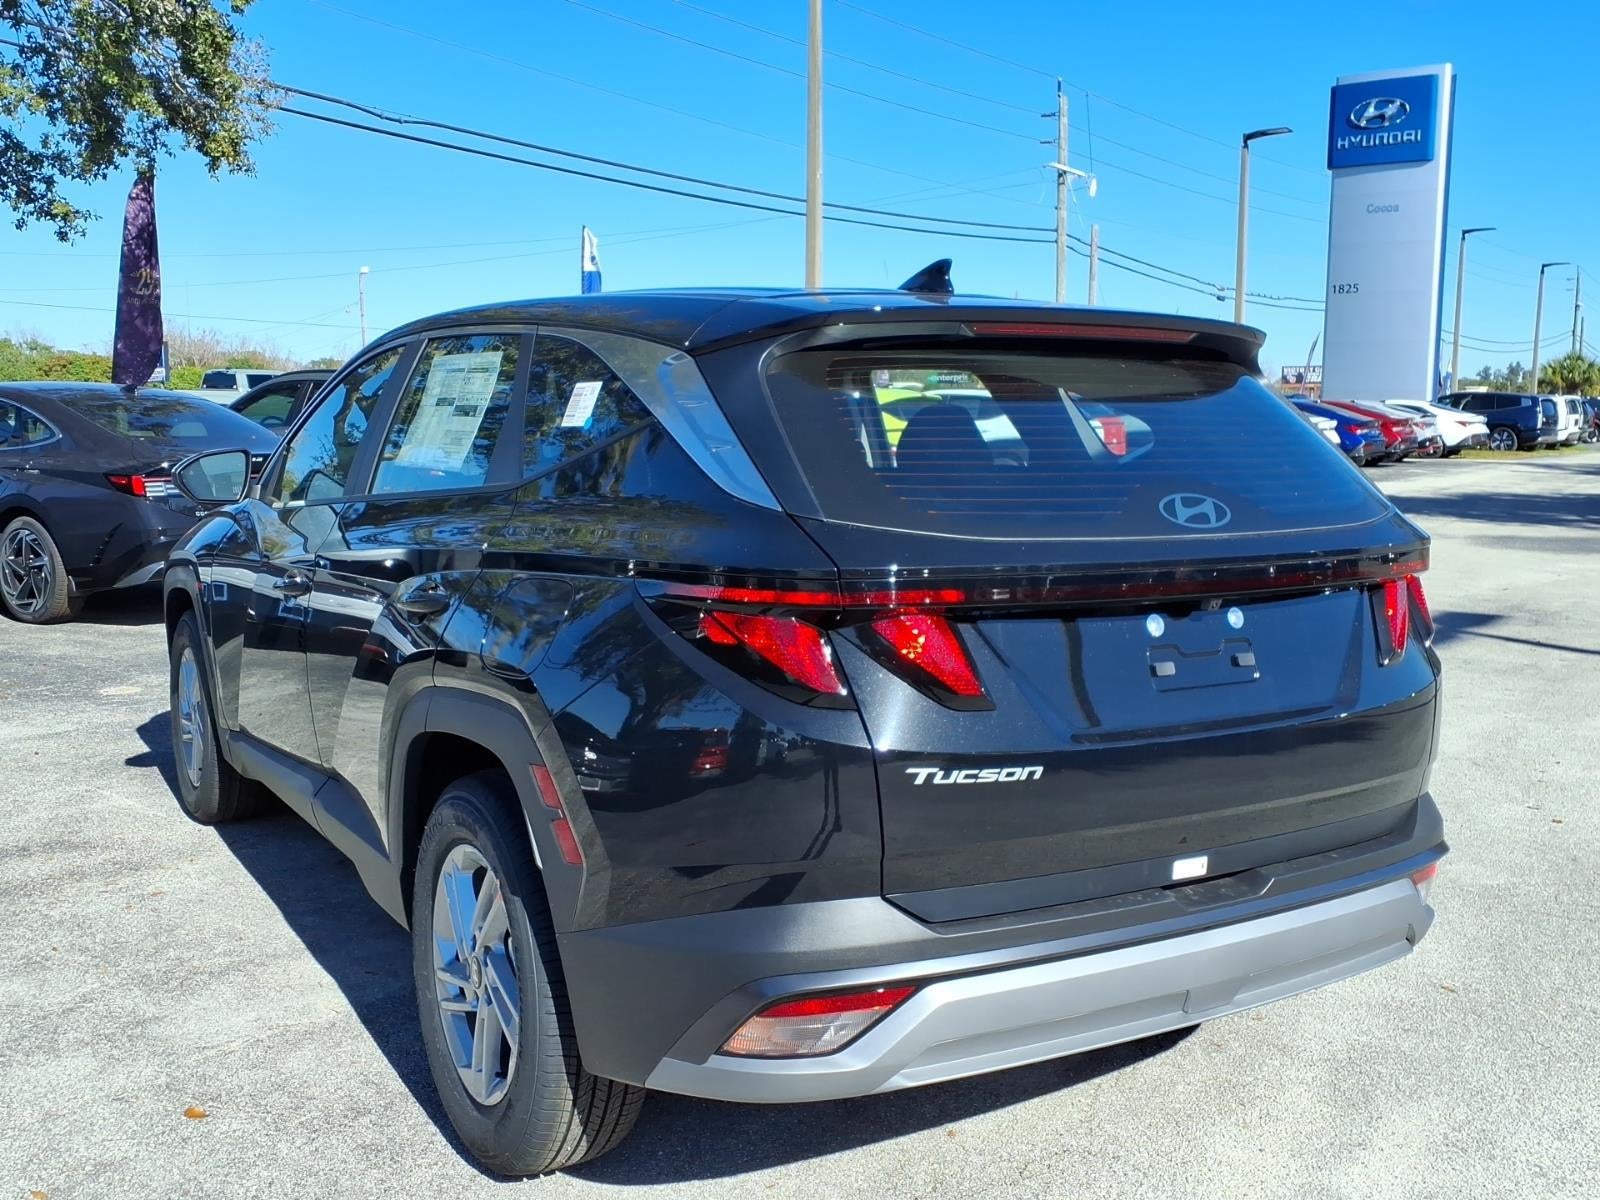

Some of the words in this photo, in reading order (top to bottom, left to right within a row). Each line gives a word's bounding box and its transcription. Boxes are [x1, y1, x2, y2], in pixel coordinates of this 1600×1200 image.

[1337, 129, 1421, 149] HYUNDAI
[1366, 203, 1399, 214] Cocoa
[1333, 283, 1359, 294] 1825
